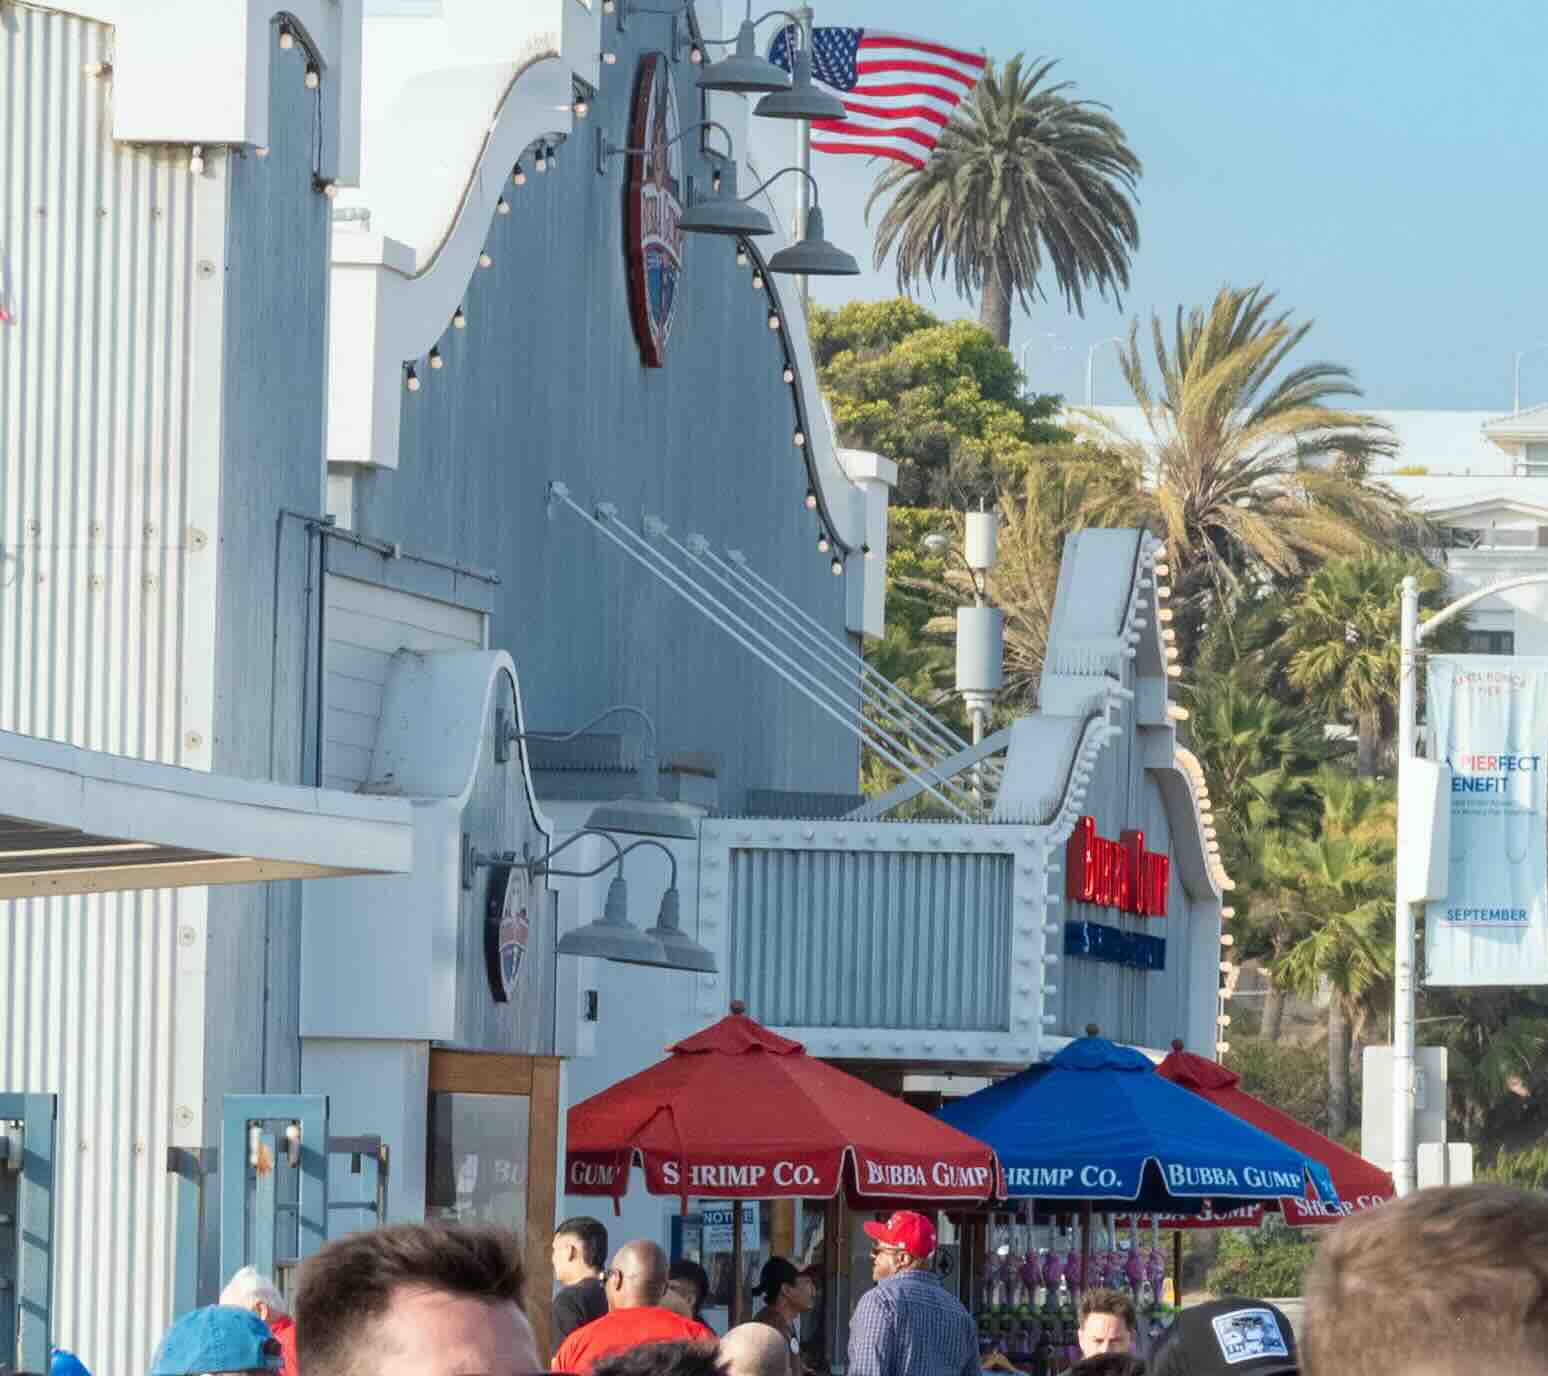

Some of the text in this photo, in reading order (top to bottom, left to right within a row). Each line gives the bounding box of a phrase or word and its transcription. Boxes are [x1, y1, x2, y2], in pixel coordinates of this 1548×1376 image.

[1459, 754, 1541, 772] PIERFECT
[1450, 776, 1508, 793] ENEFIT
[1447, 908, 1528, 922] SEPTEMBER
[570, 1160, 619, 1186] GUM
[866, 1161, 925, 1186] BUBBA
[931, 1161, 988, 1187] GUMP
[1002, 1167, 1073, 1188] HRIMP
[1168, 1162, 1237, 1186] BUBBA
[1243, 1165, 1300, 1189] GUMP
[704, 1209, 752, 1224] NOTIE
